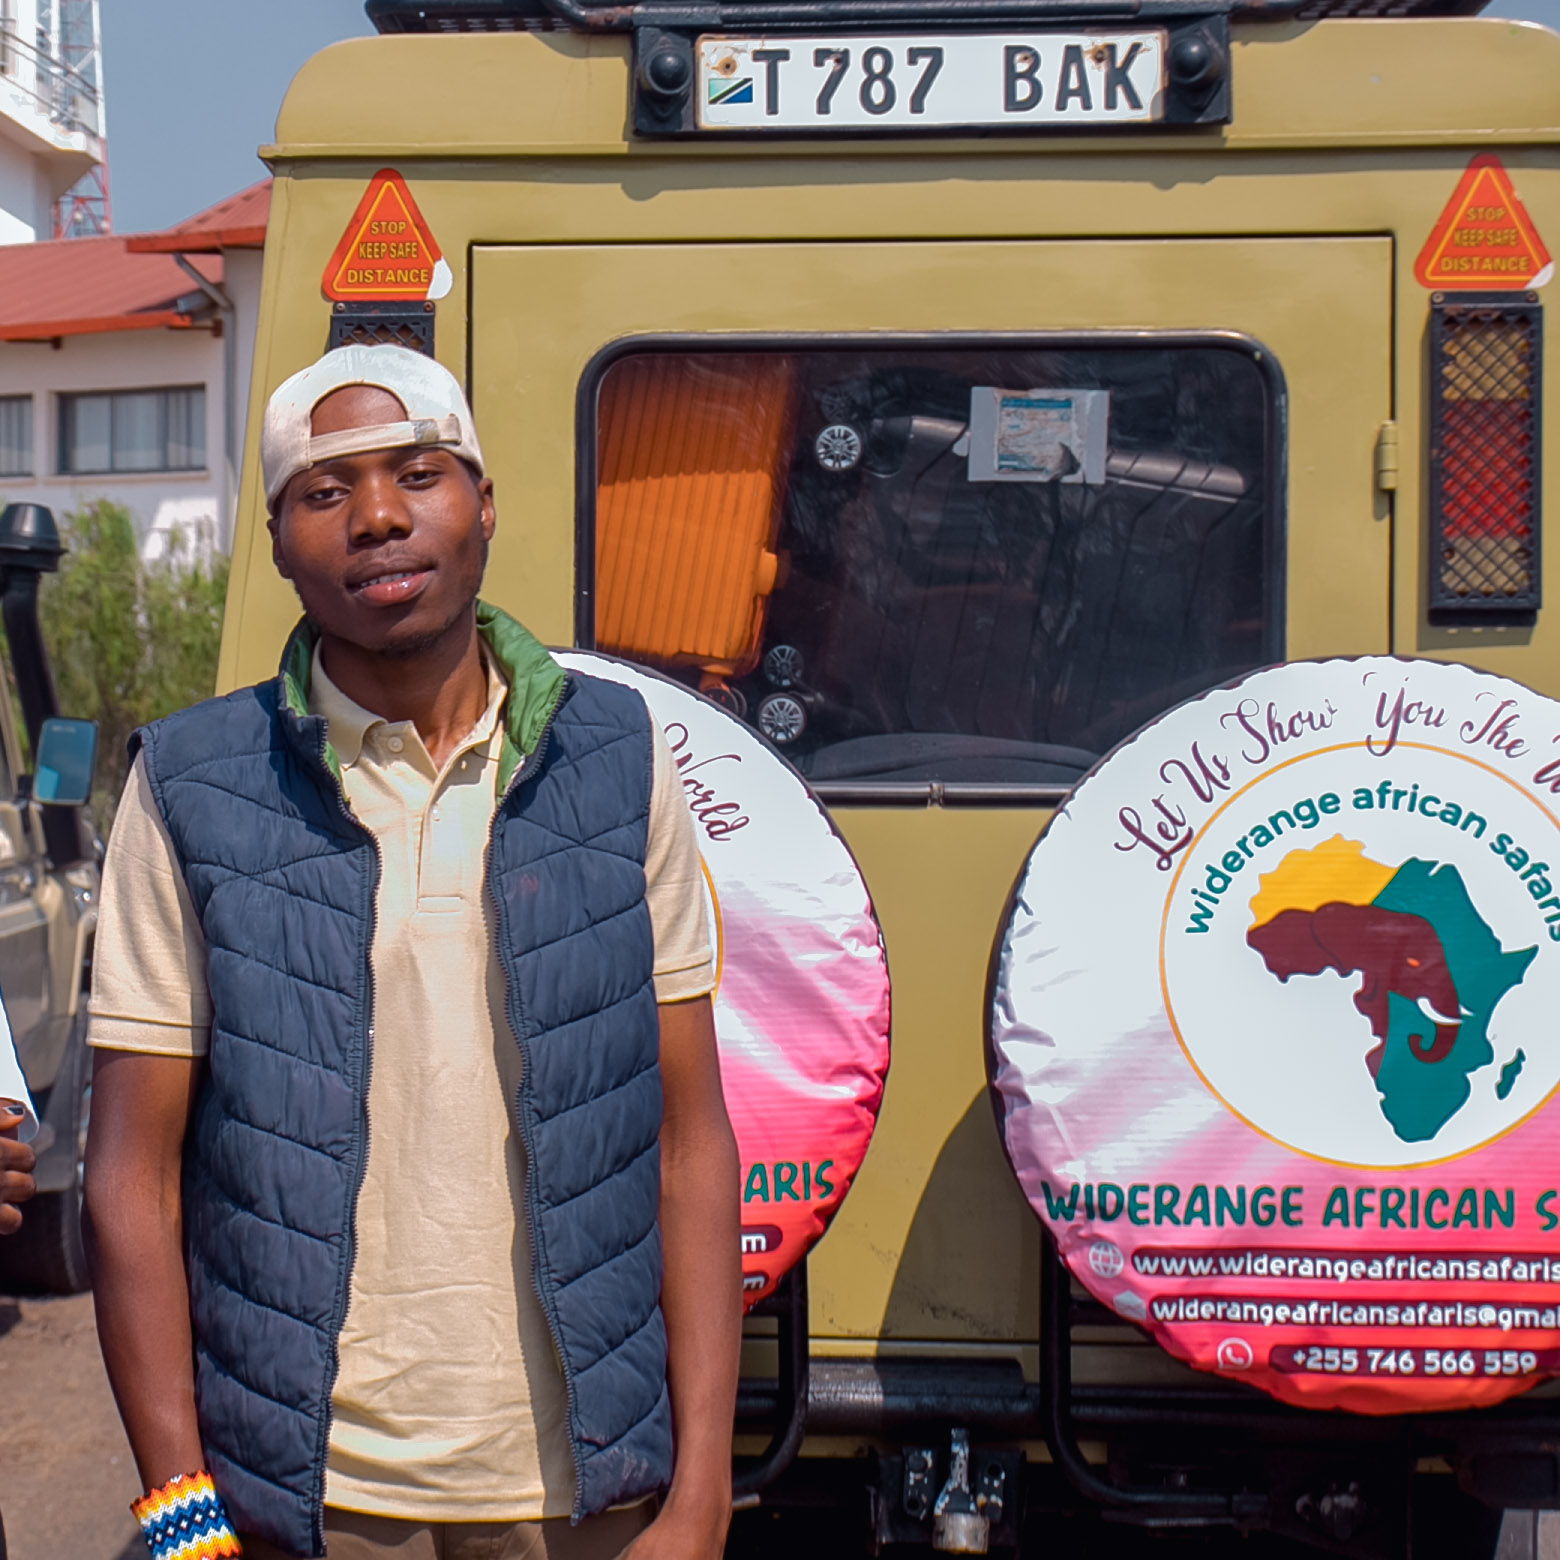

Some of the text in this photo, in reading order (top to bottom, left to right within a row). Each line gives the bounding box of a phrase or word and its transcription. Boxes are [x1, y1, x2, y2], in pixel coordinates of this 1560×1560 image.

[752, 42, 1143, 115] T 787 BAK
[1467, 207, 1505, 221] STOP
[371, 221, 406, 234] STOP
[1454, 229, 1484, 246] KEEP
[359, 242, 417, 259] KEEP SAFE
[1441, 256, 1529, 272] DISTANCE
[347, 269, 429, 283] DISTANCE
[1114, 794, 1194, 871] Let
[1160, 741, 1231, 803] Us
[1219, 698, 1337, 764] Show
[1460, 692, 1530, 758] The
[1185, 792, 1341, 934] widerange
[1352, 780, 1487, 839] african
[741, 1159, 834, 1203] ARIS
[1041, 1181, 1304, 1227] WIDERANGE
[1322, 1186, 1515, 1230] AFRICAN
[1293, 1346, 1537, 1375] +255 746 566 559
